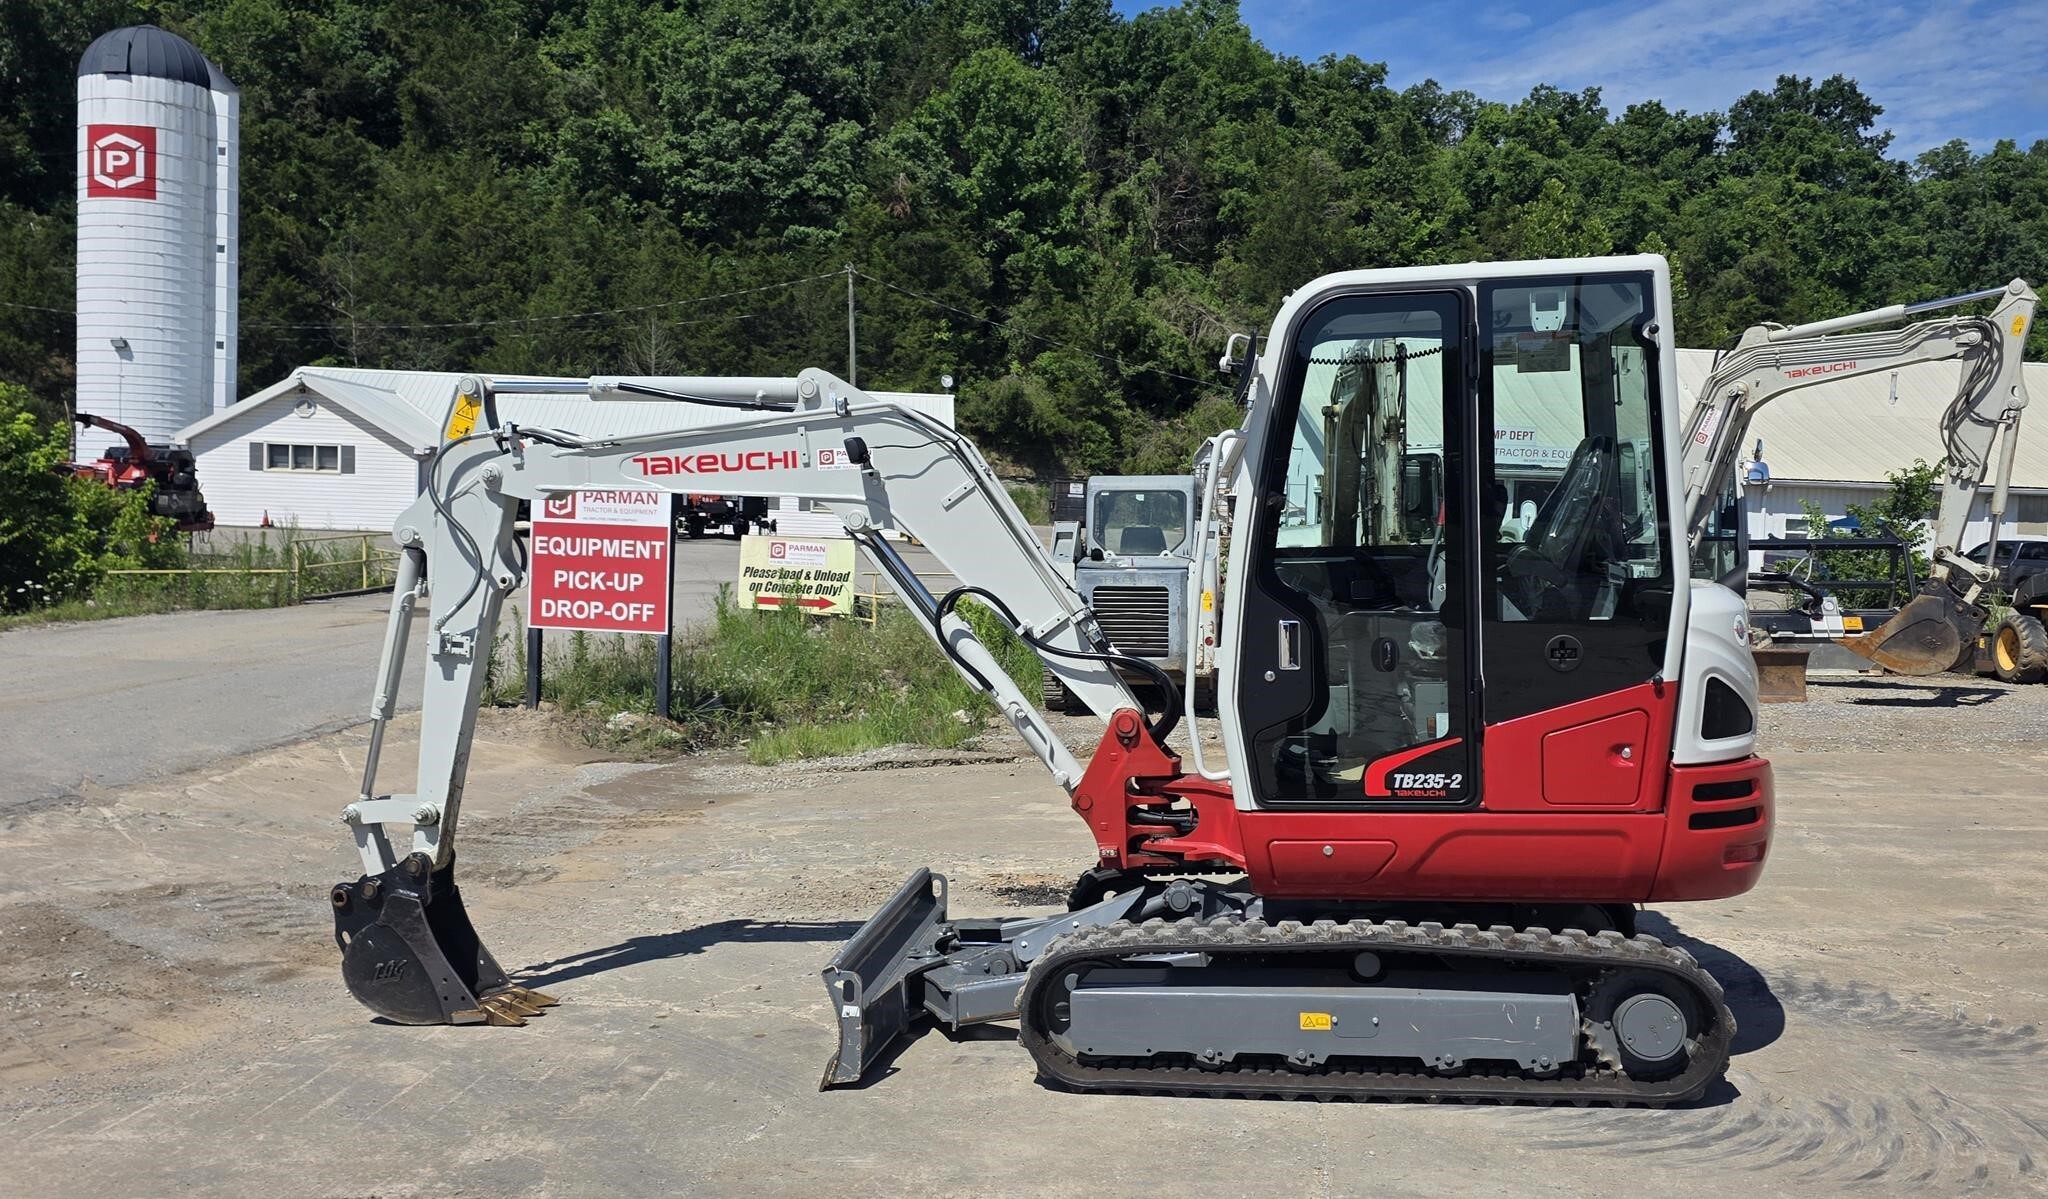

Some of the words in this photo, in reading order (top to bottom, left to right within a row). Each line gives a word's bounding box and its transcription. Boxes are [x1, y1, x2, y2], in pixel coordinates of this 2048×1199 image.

[106, 150, 130, 173] P
[1784, 361, 1857, 379] TAKEUCHI
[1510, 431, 1535, 441] DEPT
[1494, 448, 1540, 457] TRACTOR
[1541, 450, 1549, 458] &
[632, 450, 798, 476] TAKEUCHI
[583, 491, 658, 505] PARMAN
[620, 508, 658, 516] EQUIPMENT
[534, 535, 665, 560] EQUIPMENT
[789, 544, 826, 552] PARMAN
[554, 570, 644, 592] PICK-UP
[743, 566, 778, 578] Please
[778, 567, 803, 580] Load
[804, 570, 811, 580] &
[814, 570, 851, 582] Unload
[749, 582, 763, 592] on
[814, 583, 843, 597] Only!
[541, 599, 656, 622] DROP-OFF
[1393, 773, 1463, 789] TB235-2
